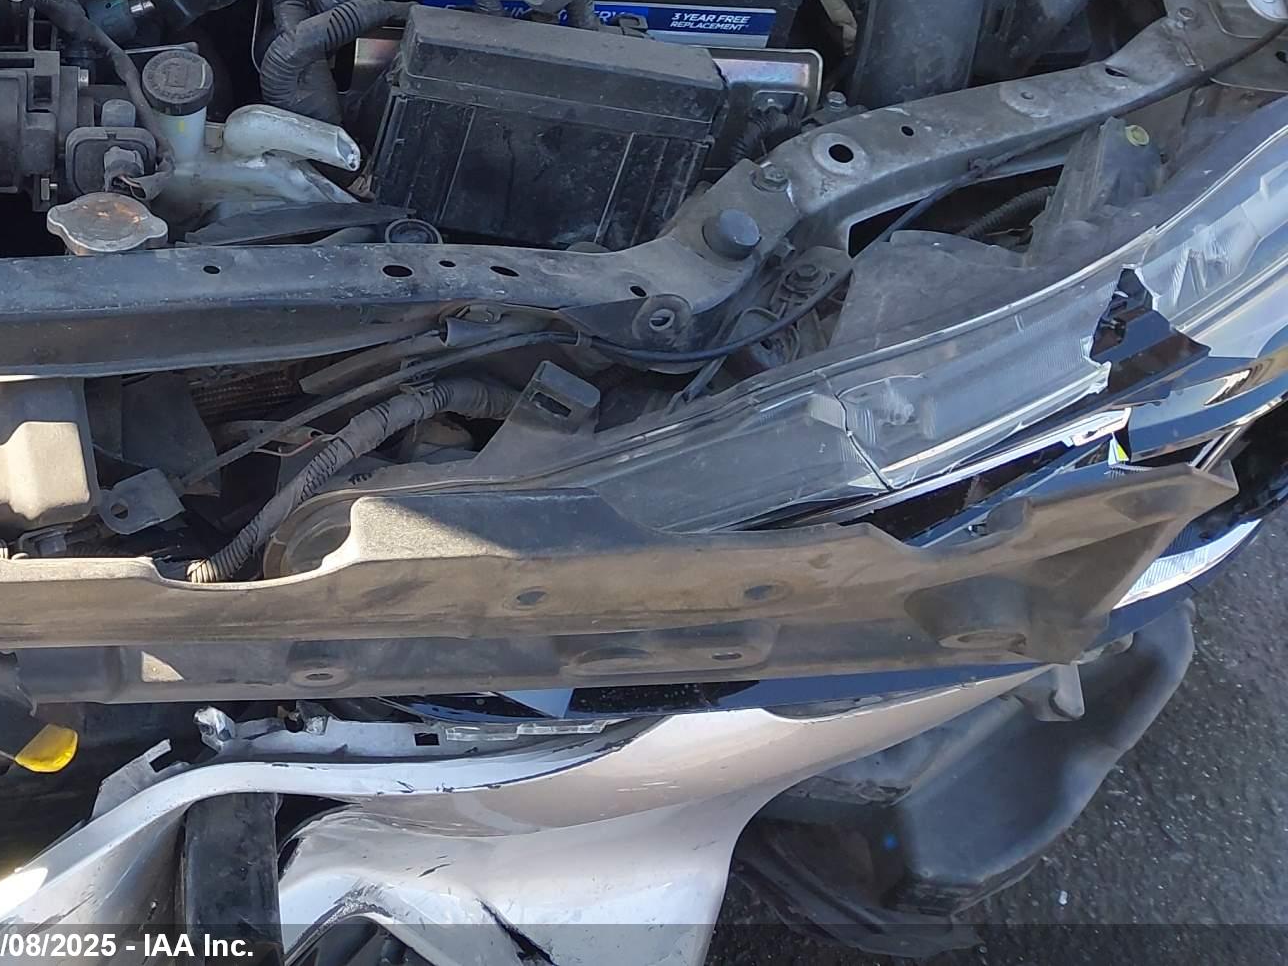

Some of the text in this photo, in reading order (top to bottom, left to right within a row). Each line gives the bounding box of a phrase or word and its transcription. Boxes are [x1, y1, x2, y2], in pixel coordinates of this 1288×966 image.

[672, 12, 751, 24] 3 YEAR FREE
